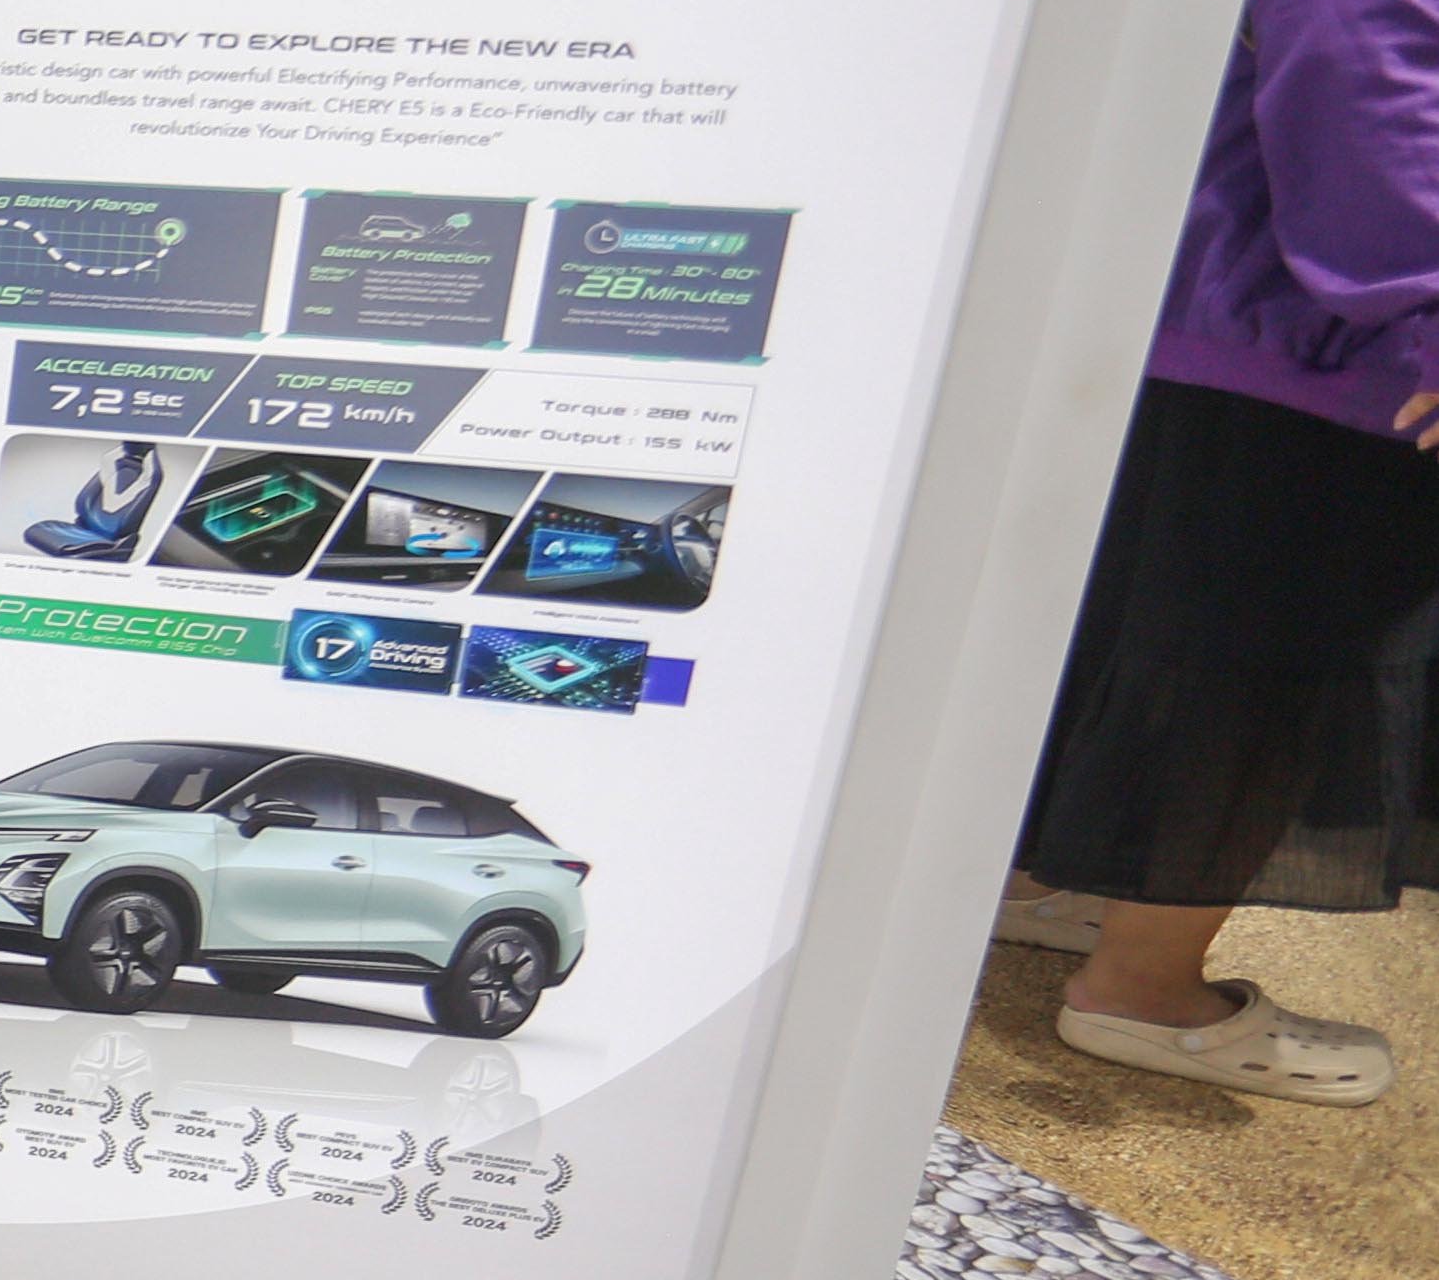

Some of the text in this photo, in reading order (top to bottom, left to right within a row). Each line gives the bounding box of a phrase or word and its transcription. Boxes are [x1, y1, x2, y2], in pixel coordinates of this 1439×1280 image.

[17, 28, 637, 59] GET READY TO EXPLORE THE NEW ERA
[41, 61, 103, 82] design
[108, 66, 137, 79] car
[142, 64, 182, 81] with
[186, 66, 271, 86] powerful
[277, 68, 388, 91] Electrifying
[392, 72, 526, 93] Performance,
[533, 78, 653, 97] unwavering
[660, 79, 738, 99] battery
[3, 91, 38, 105] and
[43, 90, 137, 108] boundless
[142, 93, 195, 110] travel
[200, 97, 255, 114] range
[323, 98, 394, 114] CHERY
[399, 100, 425, 116] E5
[430, 102, 444, 117] is
[451, 106, 463, 118] a
[469, 103, 596, 124] Eco-Friendly
[603, 110, 635, 123] car
[641, 108, 683, 125] that
[690, 110, 726, 126] will
[130, 120, 251, 138] revolutionize
[257, 123, 298, 139] Your
[304, 125, 375, 145] Driving
[13, 194, 90, 212] Battery
[91, 198, 159, 215] Range
[321, 245, 493, 265] Battery Protection
[574, 274, 645, 300] 28
[640, 285, 754, 306] Minutes
[34, 357, 215, 383] ACCELERATION
[275, 373, 415, 397] TOP SPEED
[49, 384, 185, 418] 7,2 Sec
[540, 399, 627, 418] Torque
[702, 410, 739, 425] Nm
[247, 398, 416, 429] 172 km/h
[459, 421, 534, 440] Power
[538, 426, 623, 447] Output
[694, 439, 736, 454] kW
[315, 637, 356, 660] 17
[372, 639, 449, 655] Advanced
[369, 648, 448, 669] Driving
[34, 1102, 75, 1118] 2024
[174, 1124, 217, 1139] 2024
[28, 1146, 69, 1161] 2024
[320, 1146, 364, 1161] 2024
[167, 1168, 209, 1183] 2024
[472, 1170, 517, 1186] 2024
[312, 1191, 355, 1207] 2024
[462, 1215, 507, 1231] 2024
